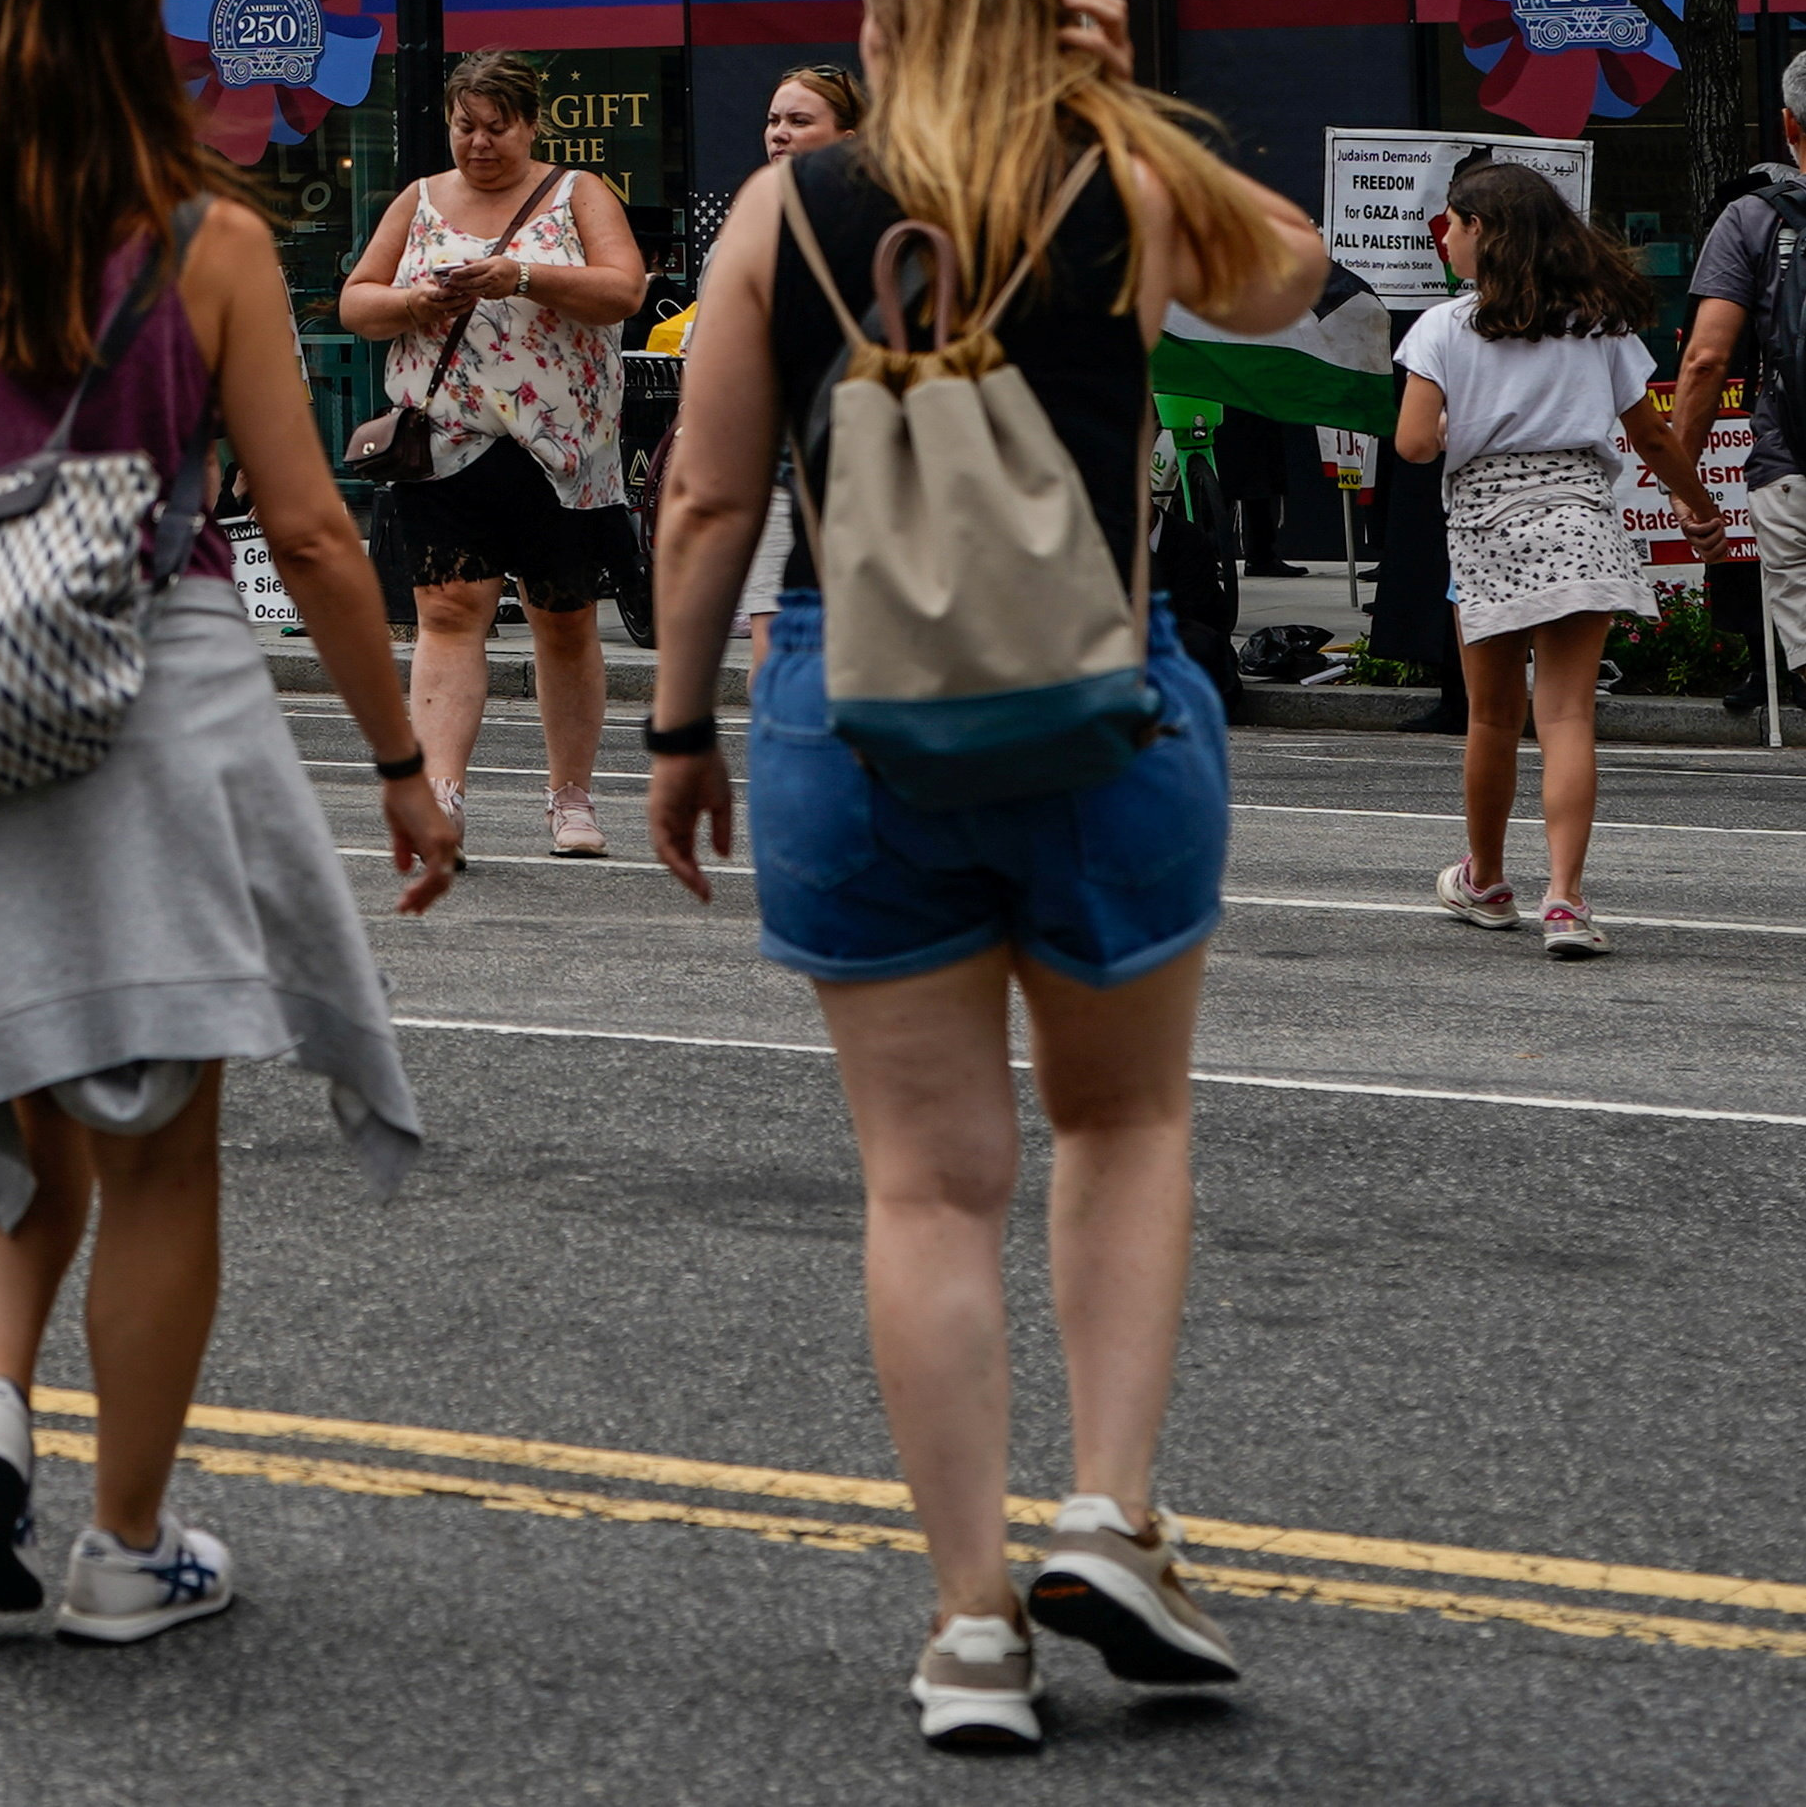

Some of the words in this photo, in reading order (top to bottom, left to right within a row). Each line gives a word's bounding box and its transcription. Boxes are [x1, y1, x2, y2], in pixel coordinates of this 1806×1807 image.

[244, 4, 289, 13] AMERICA
[237, 14, 297, 44] 250
[551, 93, 650, 129] GIFT
[541, 138, 606, 163] THE
[1337, 149, 1380, 163] Judaism
[1382, 150, 1432, 165] Demands
[1353, 175, 1415, 191] FREEDOM
[1344, 204, 1360, 219] for
[1363, 205, 1399, 220] GAZA
[1401, 207, 1425, 221] and
[1334, 234, 1361, 249] ALL
[1362, 234, 1435, 250] PALESTINE
[1345, 258, 1370, 269] forbids
[1371, 261, 1384, 271] any
[1411, 261, 1433, 270] State
[1647, 384, 1744, 413] Aunti
[1636, 462, 1747, 488] Zism
[1622, 508, 1679, 531] State
